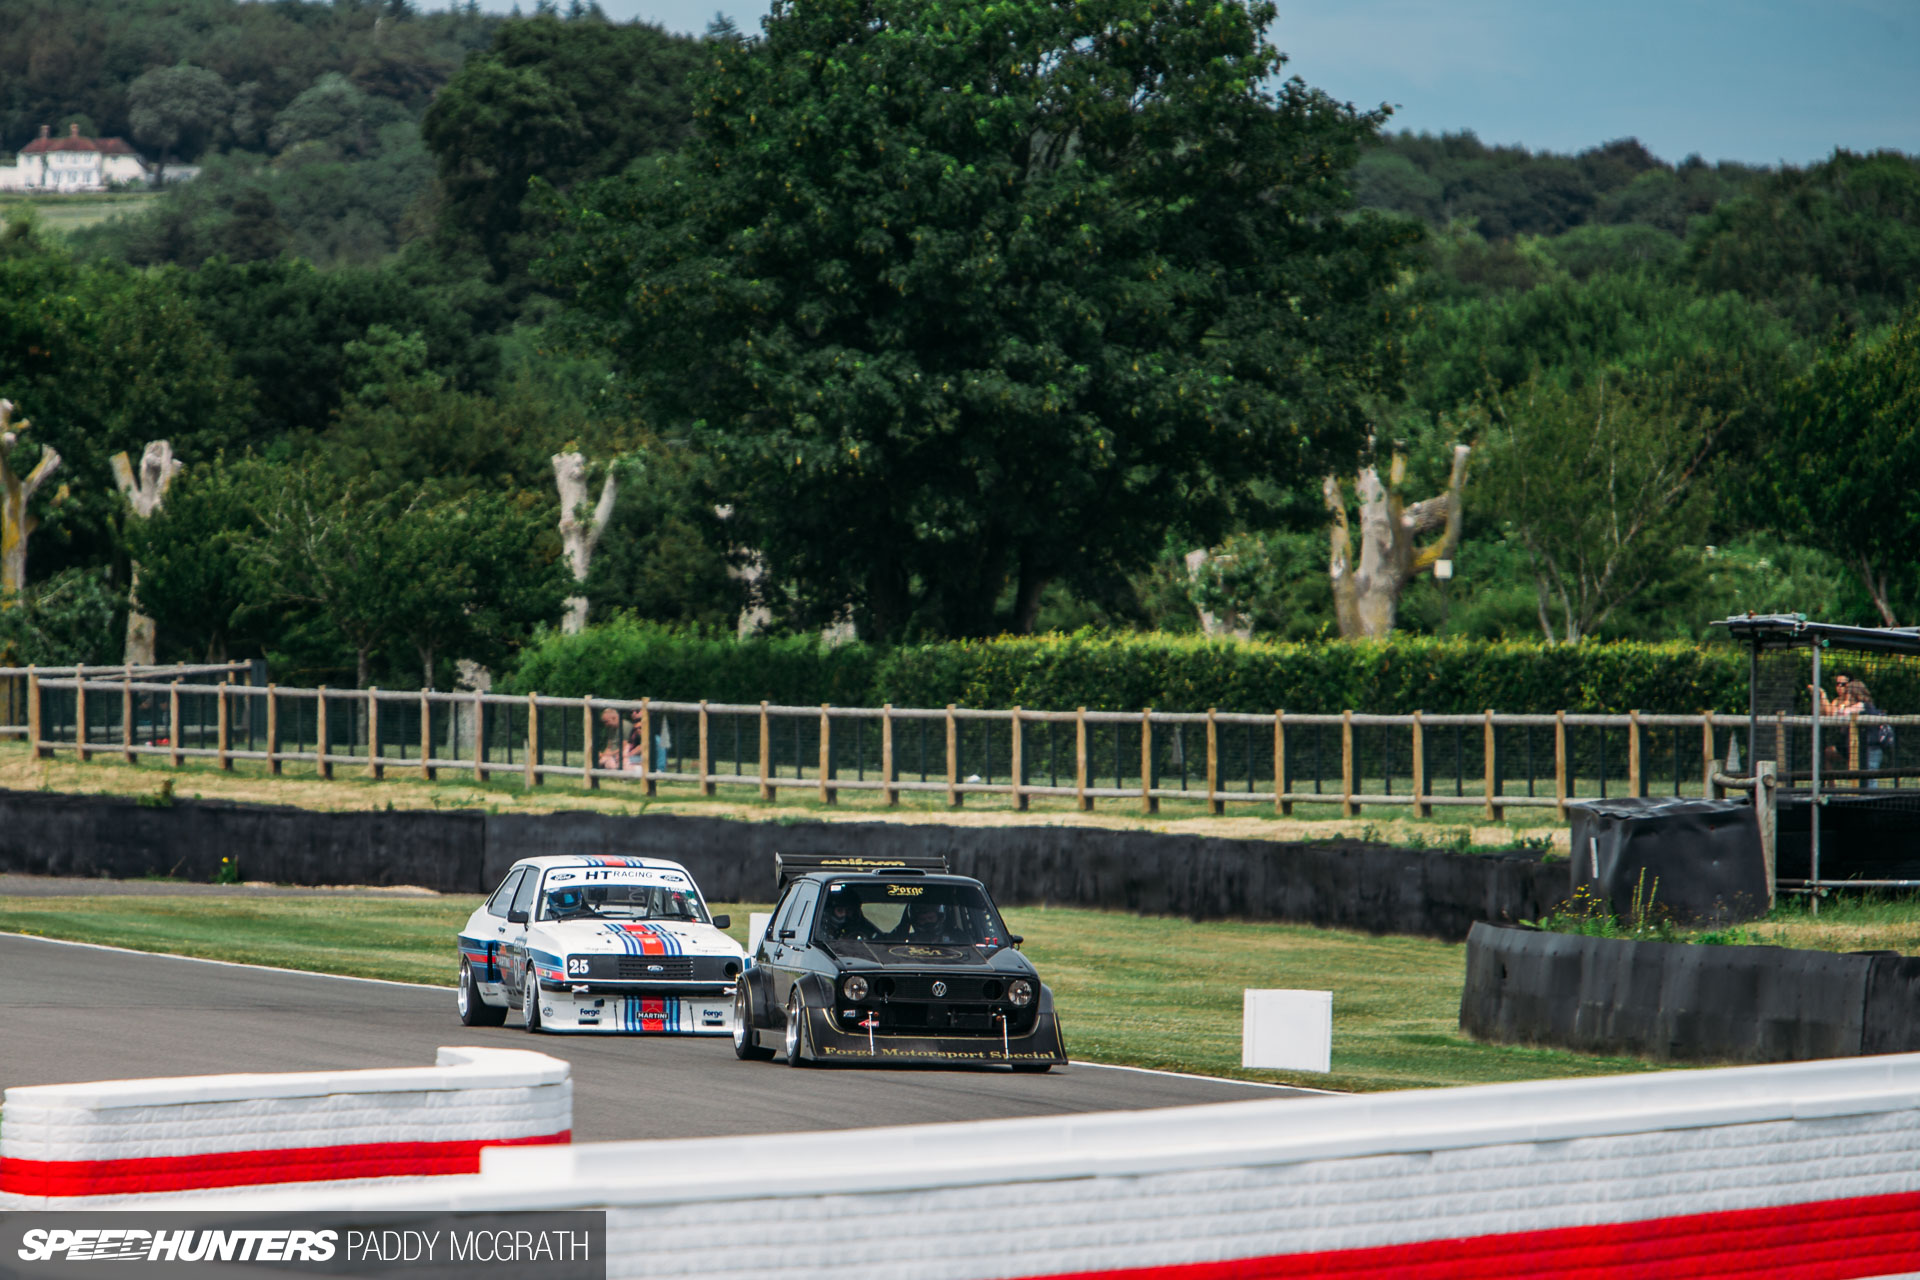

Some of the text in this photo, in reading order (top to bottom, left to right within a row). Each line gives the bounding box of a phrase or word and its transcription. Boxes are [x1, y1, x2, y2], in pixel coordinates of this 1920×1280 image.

[585, 870, 653, 880] HT RACING
[886, 884, 924, 896] Forge
[569, 958, 590, 974] 25
[580, 1008, 600, 1017] Forge
[637, 1011, 668, 1020] MARTINI
[703, 1009, 723, 1018] Forge
[881, 1048, 986, 1060] Motorsport
[990, 1051, 1056, 1061] Special
